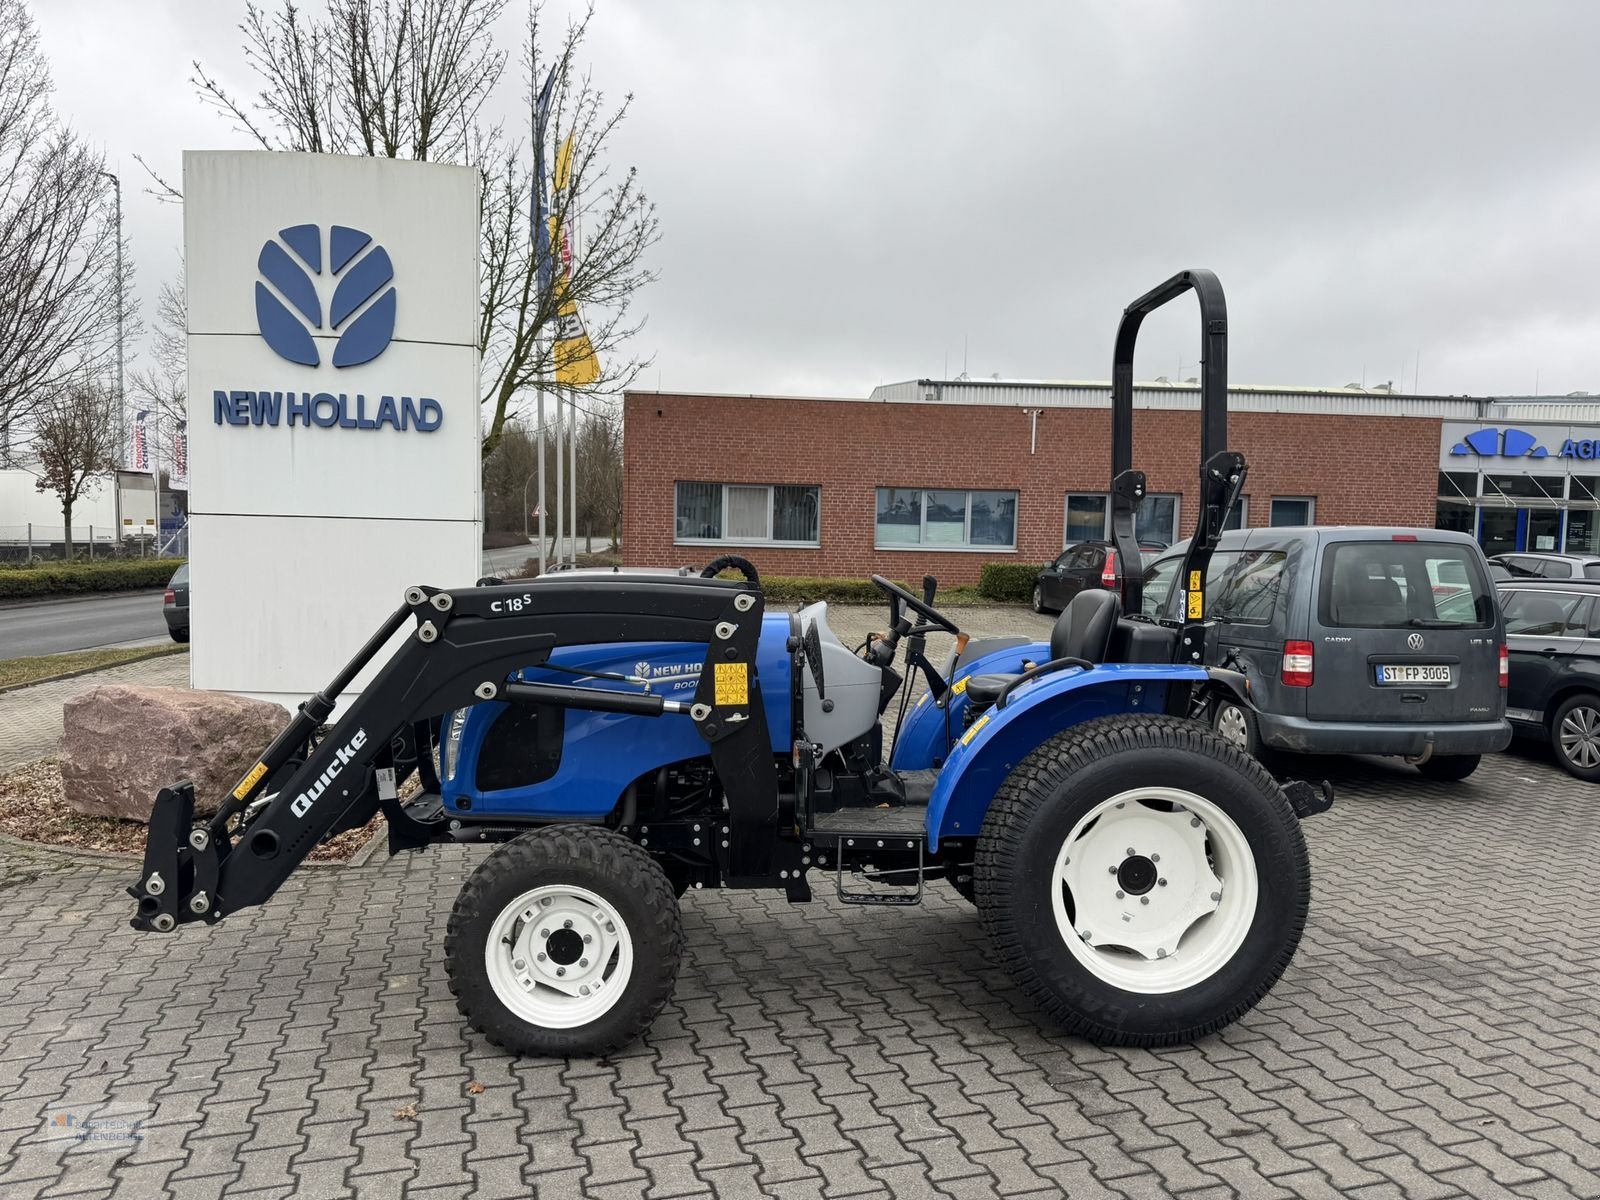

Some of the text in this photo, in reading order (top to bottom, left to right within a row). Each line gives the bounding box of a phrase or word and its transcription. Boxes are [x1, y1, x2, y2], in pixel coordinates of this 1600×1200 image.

[213, 390, 443, 432] NEW HOLLAND
[653, 662, 704, 677] NEW HO
[1384, 667, 1449, 680] ST FP 3005
[291, 730, 367, 818] Quicke
